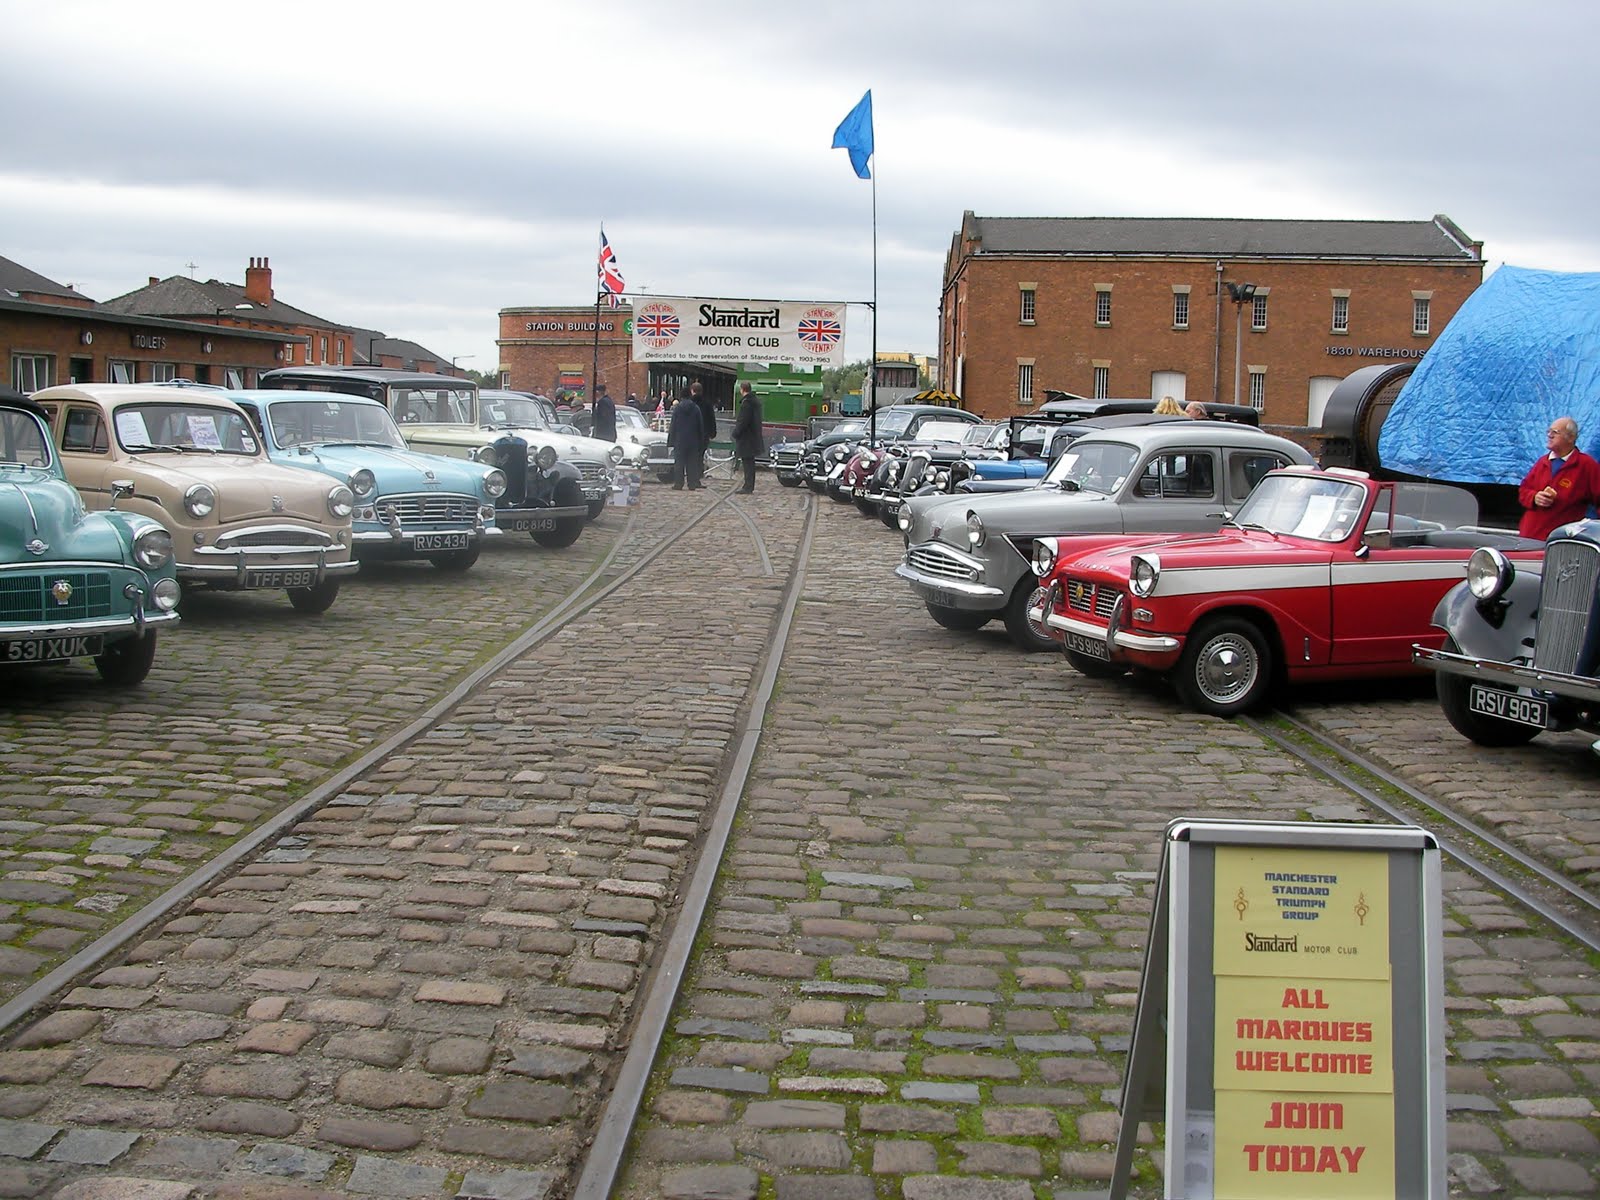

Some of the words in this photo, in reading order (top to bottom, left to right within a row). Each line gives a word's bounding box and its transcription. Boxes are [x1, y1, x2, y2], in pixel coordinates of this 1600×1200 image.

[698, 304, 780, 328] Standard
[526, 322, 564, 331] STATION
[568, 322, 613, 331] BUILDNG
[135, 335, 167, 350] TOILETS
[698, 336, 741, 347] MOTOR
[747, 337, 780, 347] CLUB
[700, 353, 739, 361] preservation
[1325, 346, 1353, 356] 1830
[1357, 347, 1426, 359] WAREHOUS
[1476, 690, 1506, 715] RSV
[1509, 698, 1541, 724] 903
[1264, 872, 1337, 884] MANCHESTER
[1272, 885, 1329, 896] STANDARD
[1276, 898, 1326, 908] TRIUMPH
[1282, 911, 1319, 920] GROUP
[1245, 932, 1298, 953] Standard
[1304, 945, 1331, 954] MOTOR
[1337, 946, 1358, 955] CLUB
[1281, 988, 1329, 1009] ALL
[1236, 1019, 1372, 1042] MARQUES
[1235, 1050, 1372, 1074] WELCOME
[1264, 1102, 1343, 1130] JOIN
[1243, 1145, 1366, 1173] TODAY
